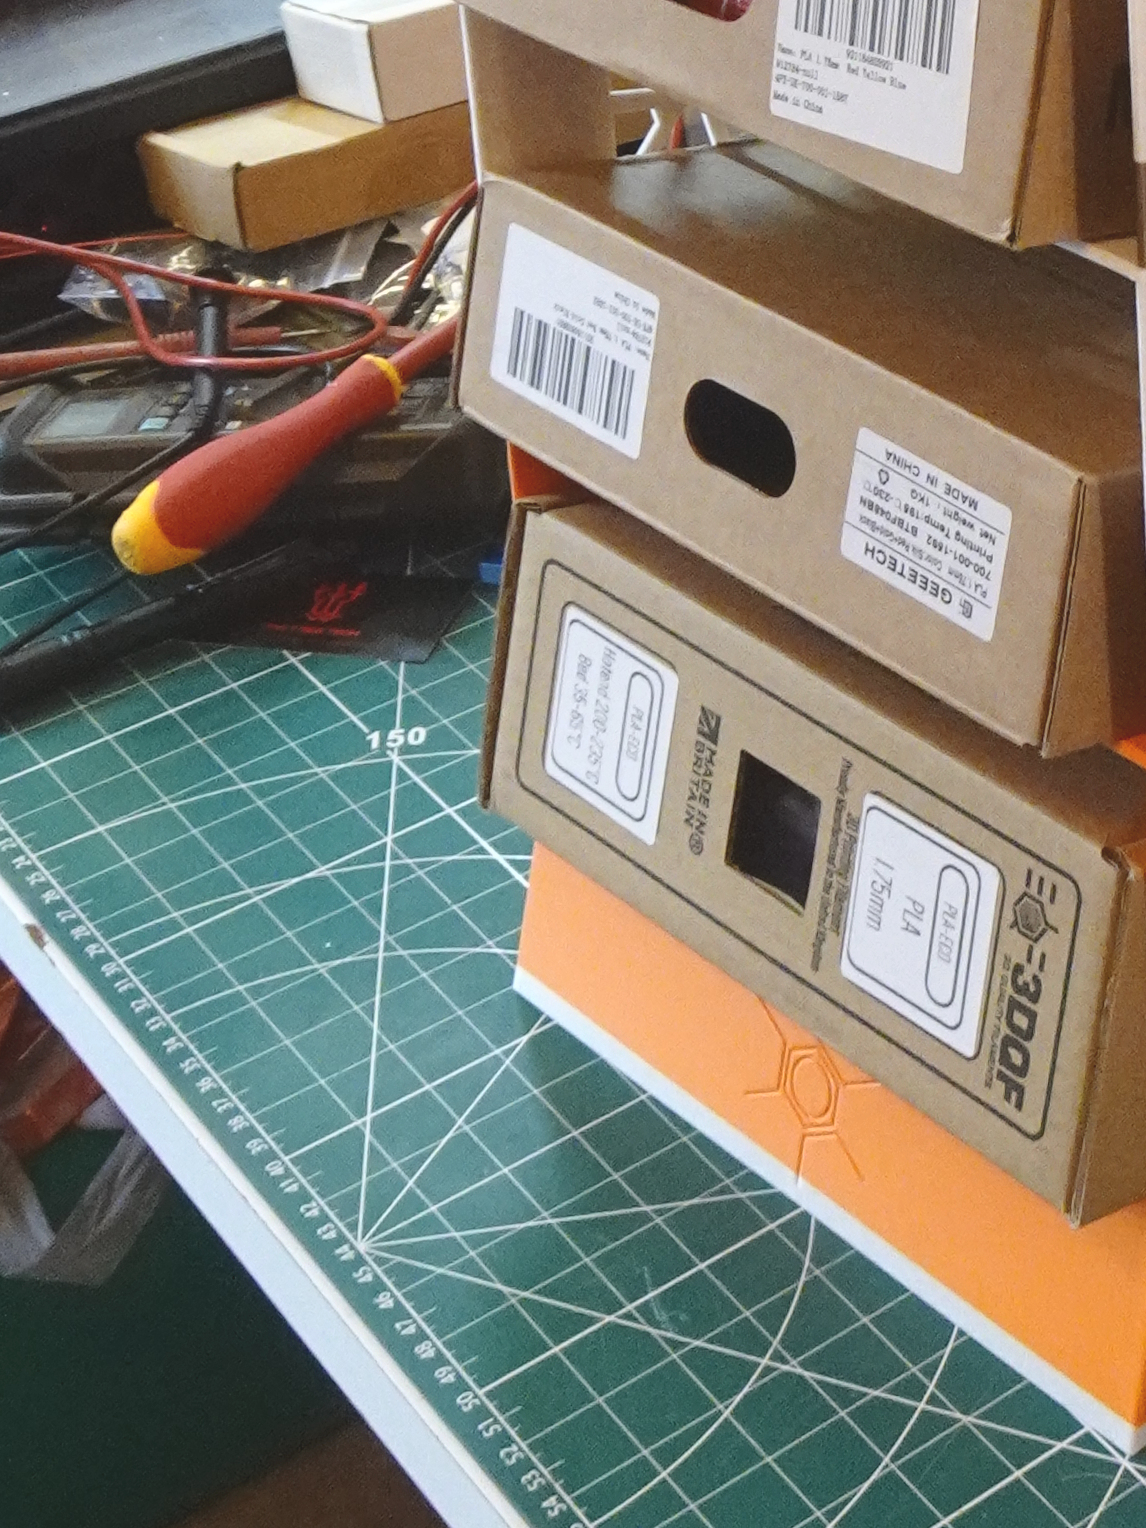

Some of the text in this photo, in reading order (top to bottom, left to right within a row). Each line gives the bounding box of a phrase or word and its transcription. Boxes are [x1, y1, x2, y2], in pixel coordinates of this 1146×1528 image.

[885, 448, 979, 512] MADE IN CHINA
[910, 488, 930, 508] 1KG
[954, 529, 994, 564] Printing
[979, 528, 996, 546] Net
[863, 541, 953, 605] GEEETECH
[575, 653, 593, 685] Bed
[597, 646, 617, 700] Hotend
[365, 727, 427, 750] 150
[683, 739, 706, 829] BRITAIN
[698, 746, 718, 809] MADE
[866, 856, 895, 932] 1.75mm
[900, 895, 926, 937] PLA
[937, 901, 959, 965] PLA-ECO
[995, 962, 1043, 1113] 3DQF
[55, 906, 79, 922] 27
[70, 923, 92, 940] 28
[84, 942, 106, 958] 29
[100, 960, 122, 977] 30
[113, 977, 135, 992] 31
[130, 996, 152, 1013] 32
[145, 1015, 166, 1031] 33
[162, 1034, 184, 1052] 34
[179, 1056, 203, 1074] 35
[195, 1075, 218, 1093] 36
[211, 1097, 235, 1113] 37
[226, 1114, 250, 1132] 38
[245, 1137, 269, 1155] 39
[264, 1159, 286, 1176] 40
[278, 1176, 300, 1193] 41
[299, 1199, 320, 1217] 42
[316, 1222, 337, 1239] 43
[334, 1243, 355, 1261] 44
[352, 1265, 373, 1283] 45
[373, 1291, 394, 1309] 46
[393, 1317, 417, 1335] 47
[413, 1339, 438, 1359] 48
[433, 1364, 456, 1384] 49
[455, 1390, 481, 1412] 50
[477, 1416, 502, 1438] 51
[499, 1443, 526, 1465] 52
[520, 1469, 546, 1491] 53
[541, 1494, 567, 1517] 54
